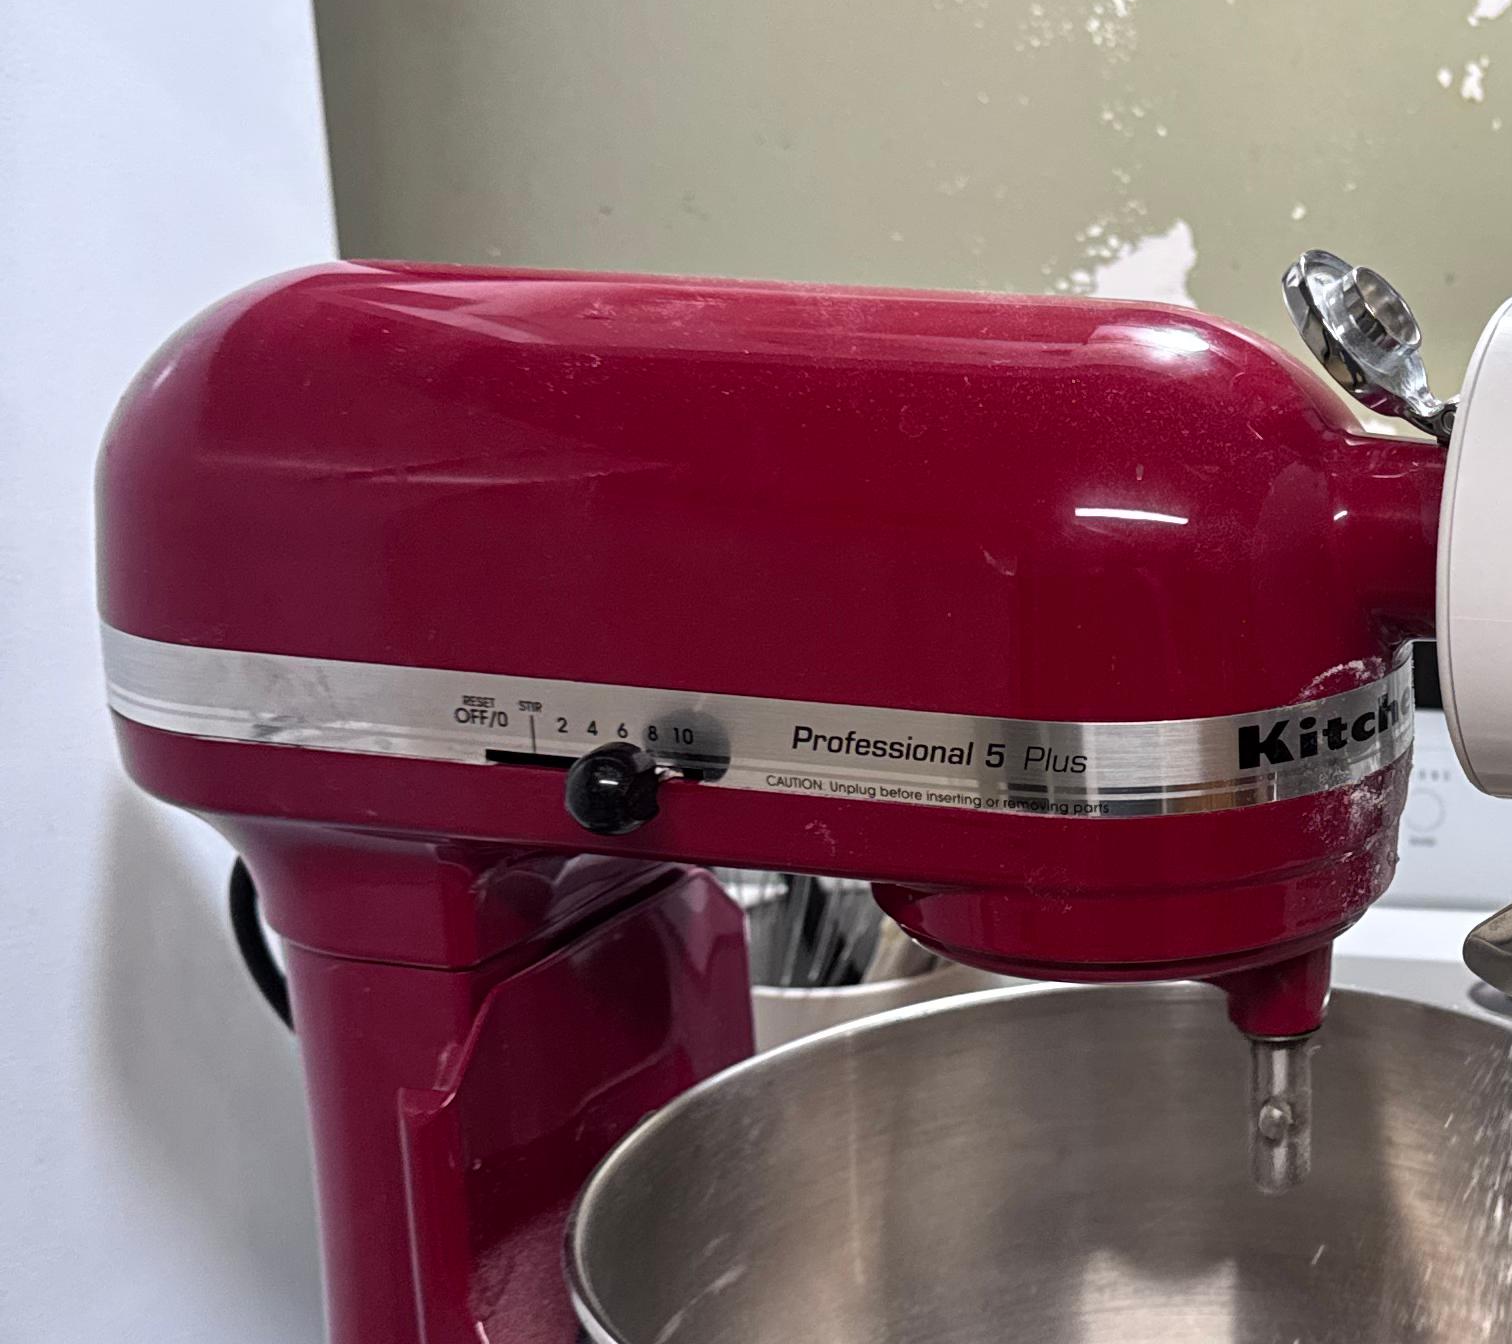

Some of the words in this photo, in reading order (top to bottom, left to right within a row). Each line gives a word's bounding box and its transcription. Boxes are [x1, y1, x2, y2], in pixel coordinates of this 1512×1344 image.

[463, 695, 495, 708] RESET
[518, 700, 542, 713] STIR
[556, 717, 568, 734] 2
[587, 720, 598, 736] 4
[617, 722, 628, 739] 6
[648, 725, 658, 741] 8
[673, 727, 694, 745] 10
[791, 725, 975, 767] Professional
[985, 743, 1006, 769] 5
[1023, 745, 1089, 774] Plus
[829, 781, 876, 799] Unplug
[880, 786, 922, 801] before
[926, 791, 982, 809] inserting
[986, 797, 1000, 808] or
[1003, 799, 1069, 815] removing
[1073, 802, 1110, 816] parts
